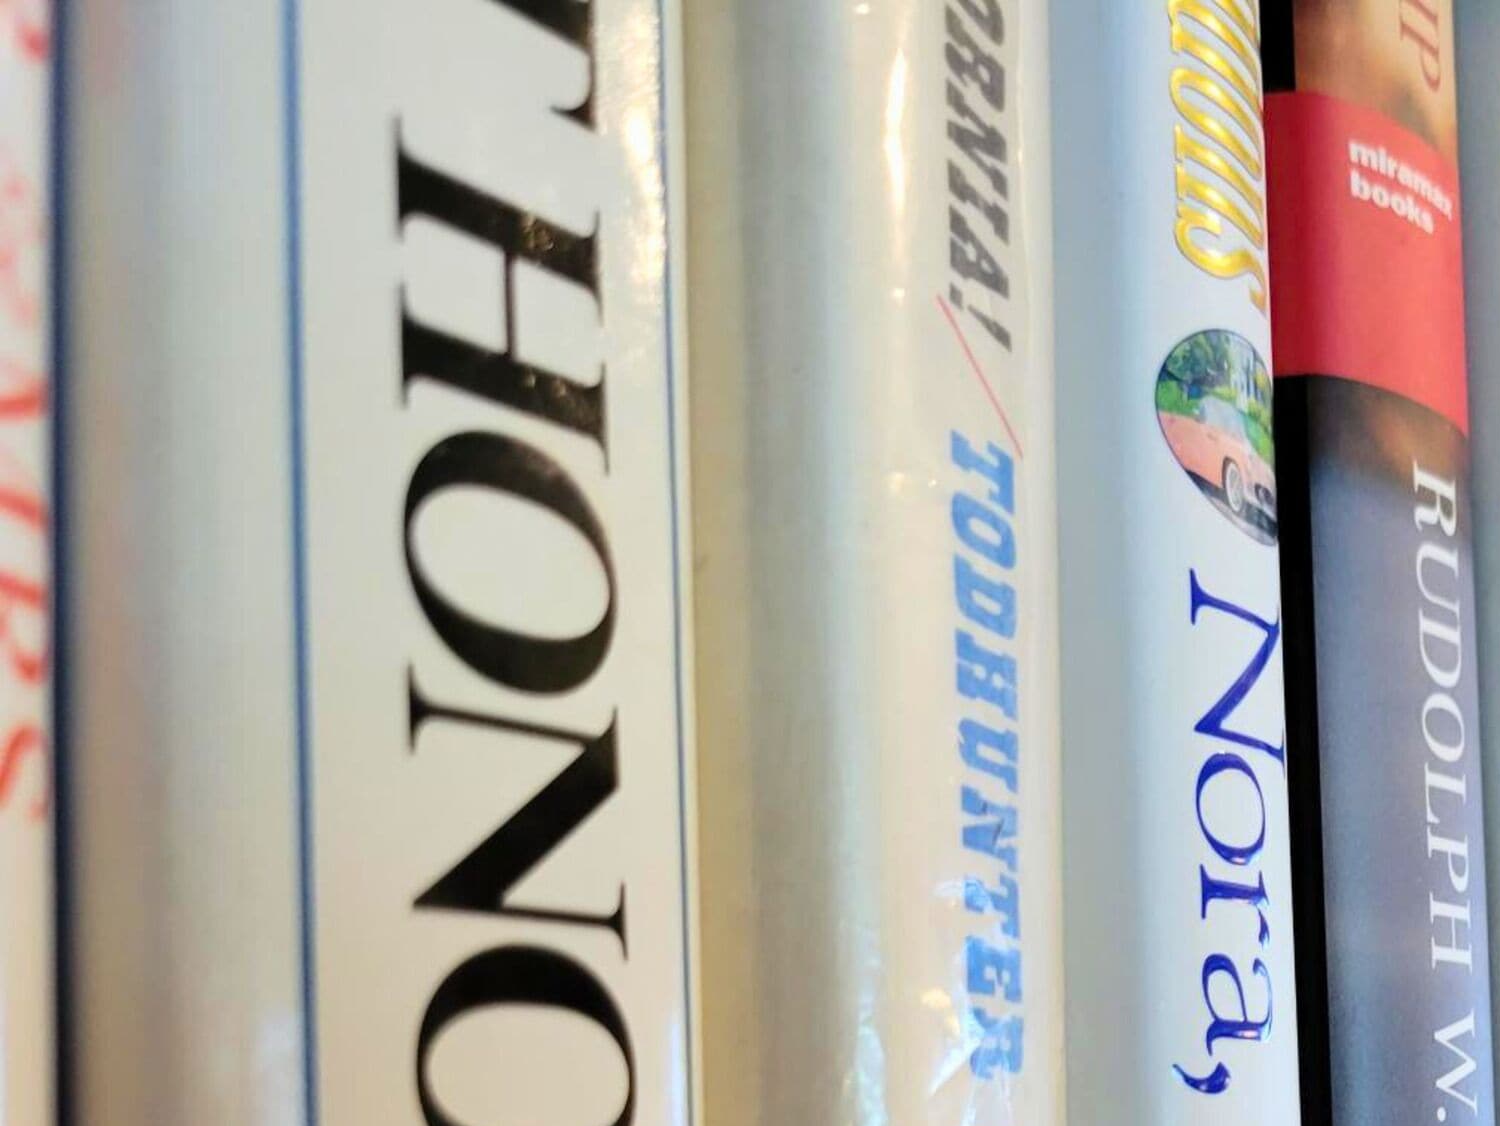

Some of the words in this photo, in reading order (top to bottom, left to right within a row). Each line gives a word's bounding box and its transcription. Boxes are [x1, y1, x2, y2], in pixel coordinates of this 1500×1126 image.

[1348, 139, 1453, 222] miramax
[1349, 168, 1435, 235] books
[949, 430, 1025, 1081] TODHUNTER
[1172, 568, 1288, 1095] Nora,
[1411, 460, 1473, 973] RUDOLPH
[1431, 1008, 1480, 1123] W.
